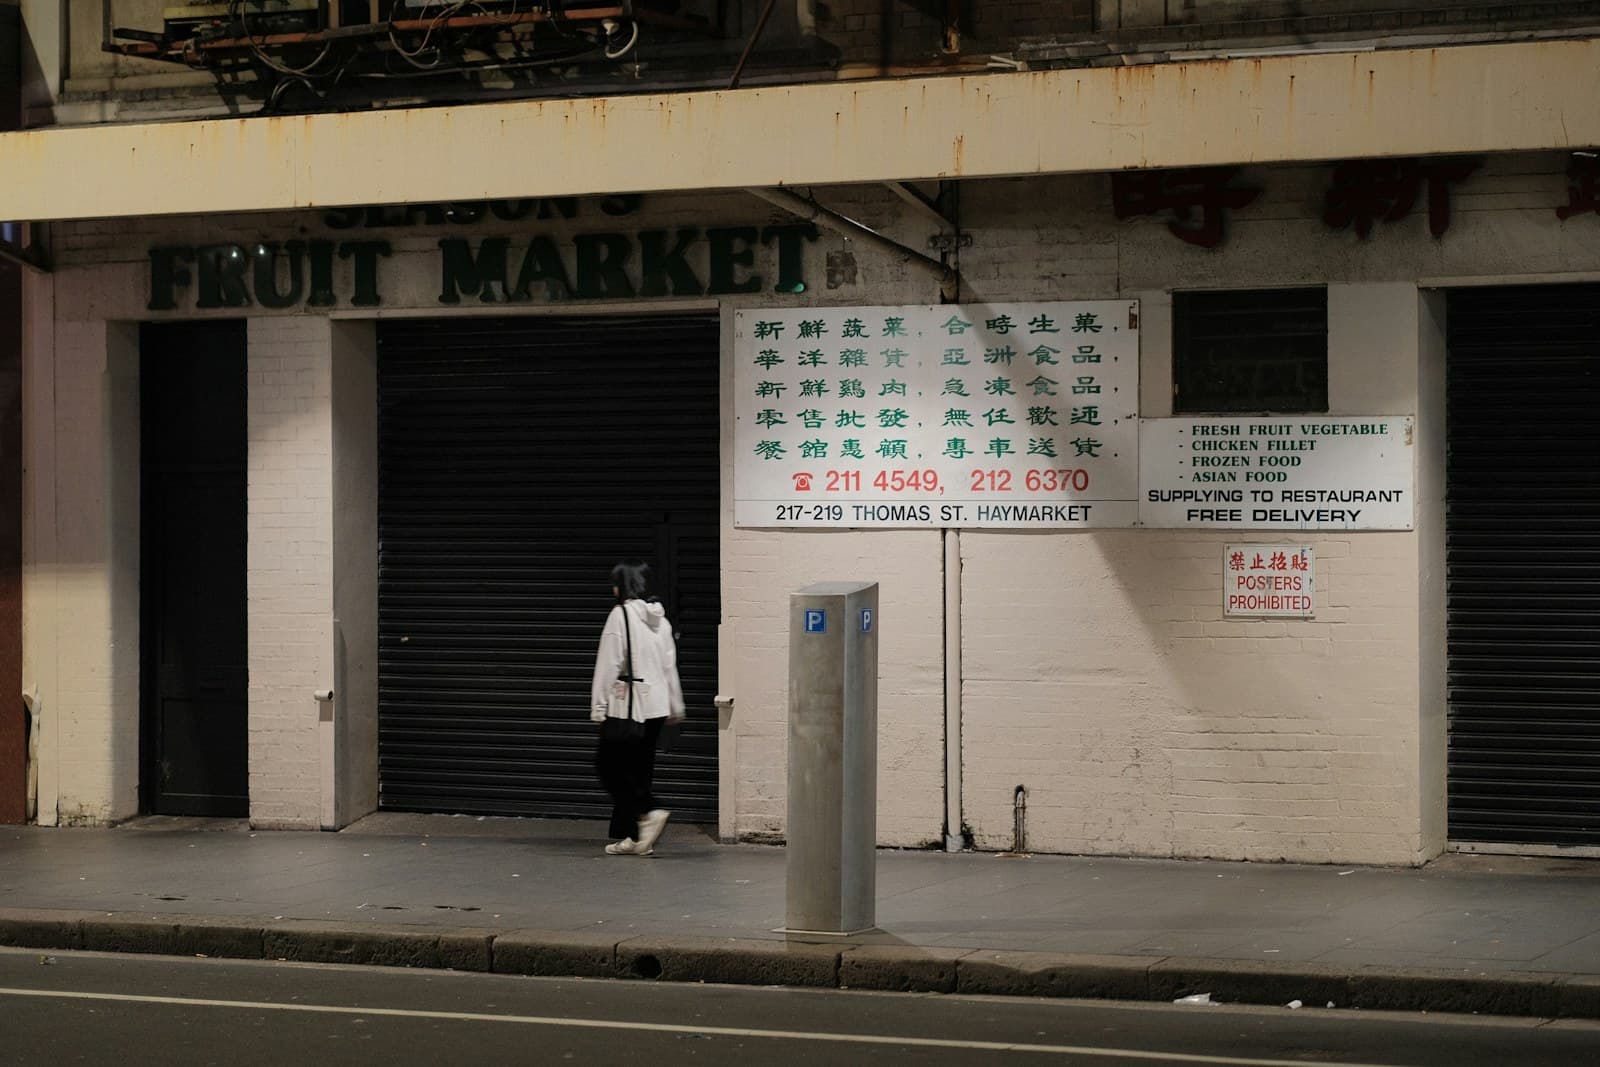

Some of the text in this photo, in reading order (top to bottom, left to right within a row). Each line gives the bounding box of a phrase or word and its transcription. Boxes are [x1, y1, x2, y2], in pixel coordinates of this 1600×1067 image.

[147, 225, 818, 308] FRUIT MARKET
[1192, 424, 1388, 435] FRESH FRUIT VEGETABLE
[1192, 440, 1316, 450] CHICKEN FILLET
[1192, 456, 1301, 466] FROZEN FOOD
[826, 469, 1088, 495] 211 4549, 212 6370
[1192, 472, 1287, 482] ASIAN FOOD
[1149, 490, 1403, 502] SUPPLYING TO RESTAURANT
[777, 505, 1091, 521] 217-219 THOMAS ST. HAYMARKET
[1188, 509, 1361, 521] FREE DELIVERY
[1230, 550, 1307, 571] 禁止招貼
[1238, 576, 1301, 590] POSTERS
[1230, 595, 1310, 609] PROHIBITED
